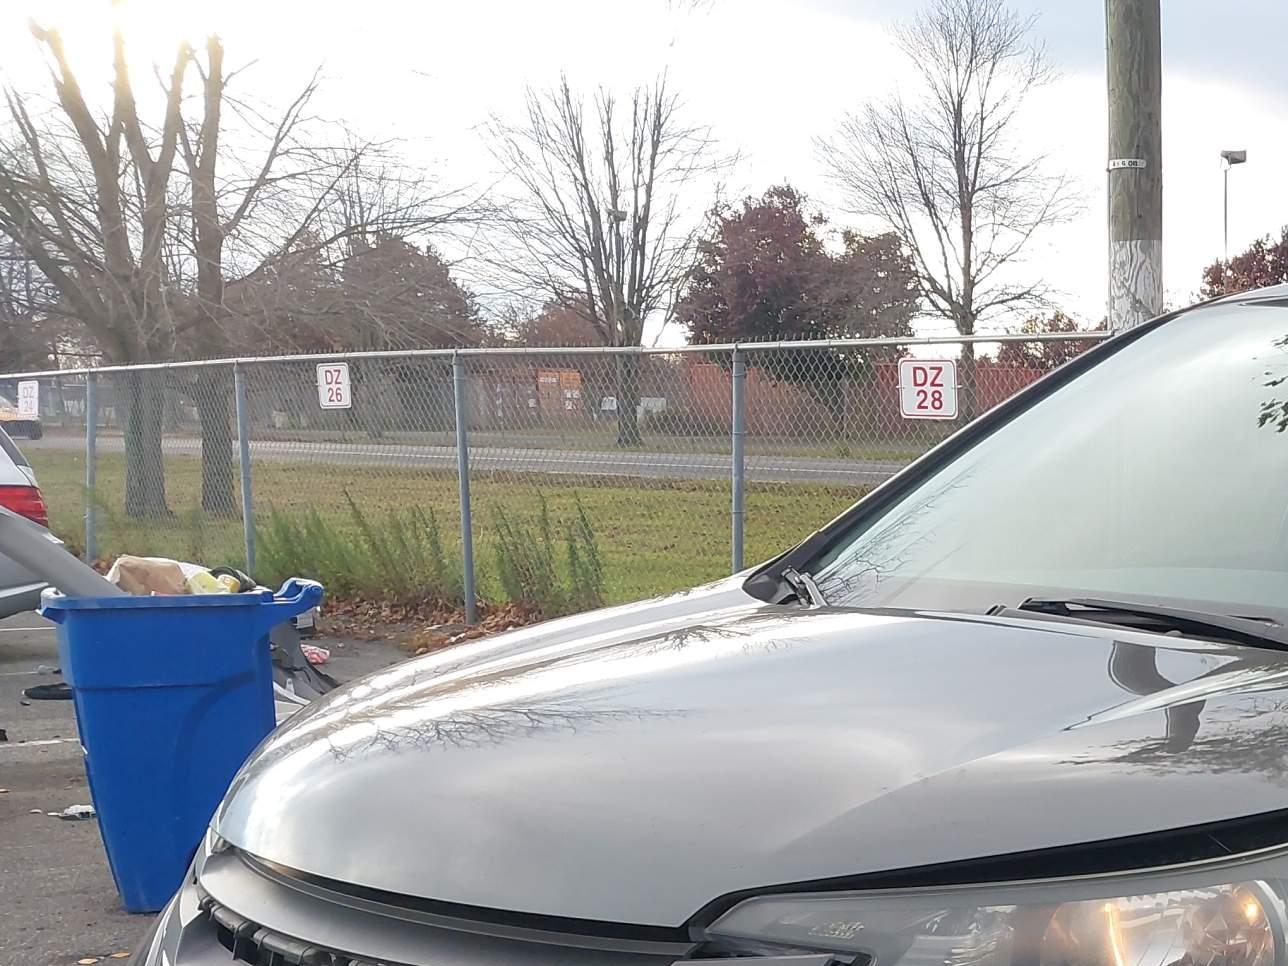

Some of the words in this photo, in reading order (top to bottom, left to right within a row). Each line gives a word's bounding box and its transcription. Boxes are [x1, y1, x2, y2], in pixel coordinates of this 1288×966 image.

[324, 369, 342, 385] DZ
[912, 366, 944, 387] DZ
[327, 387, 343, 402] 26
[916, 389, 943, 410] 28
